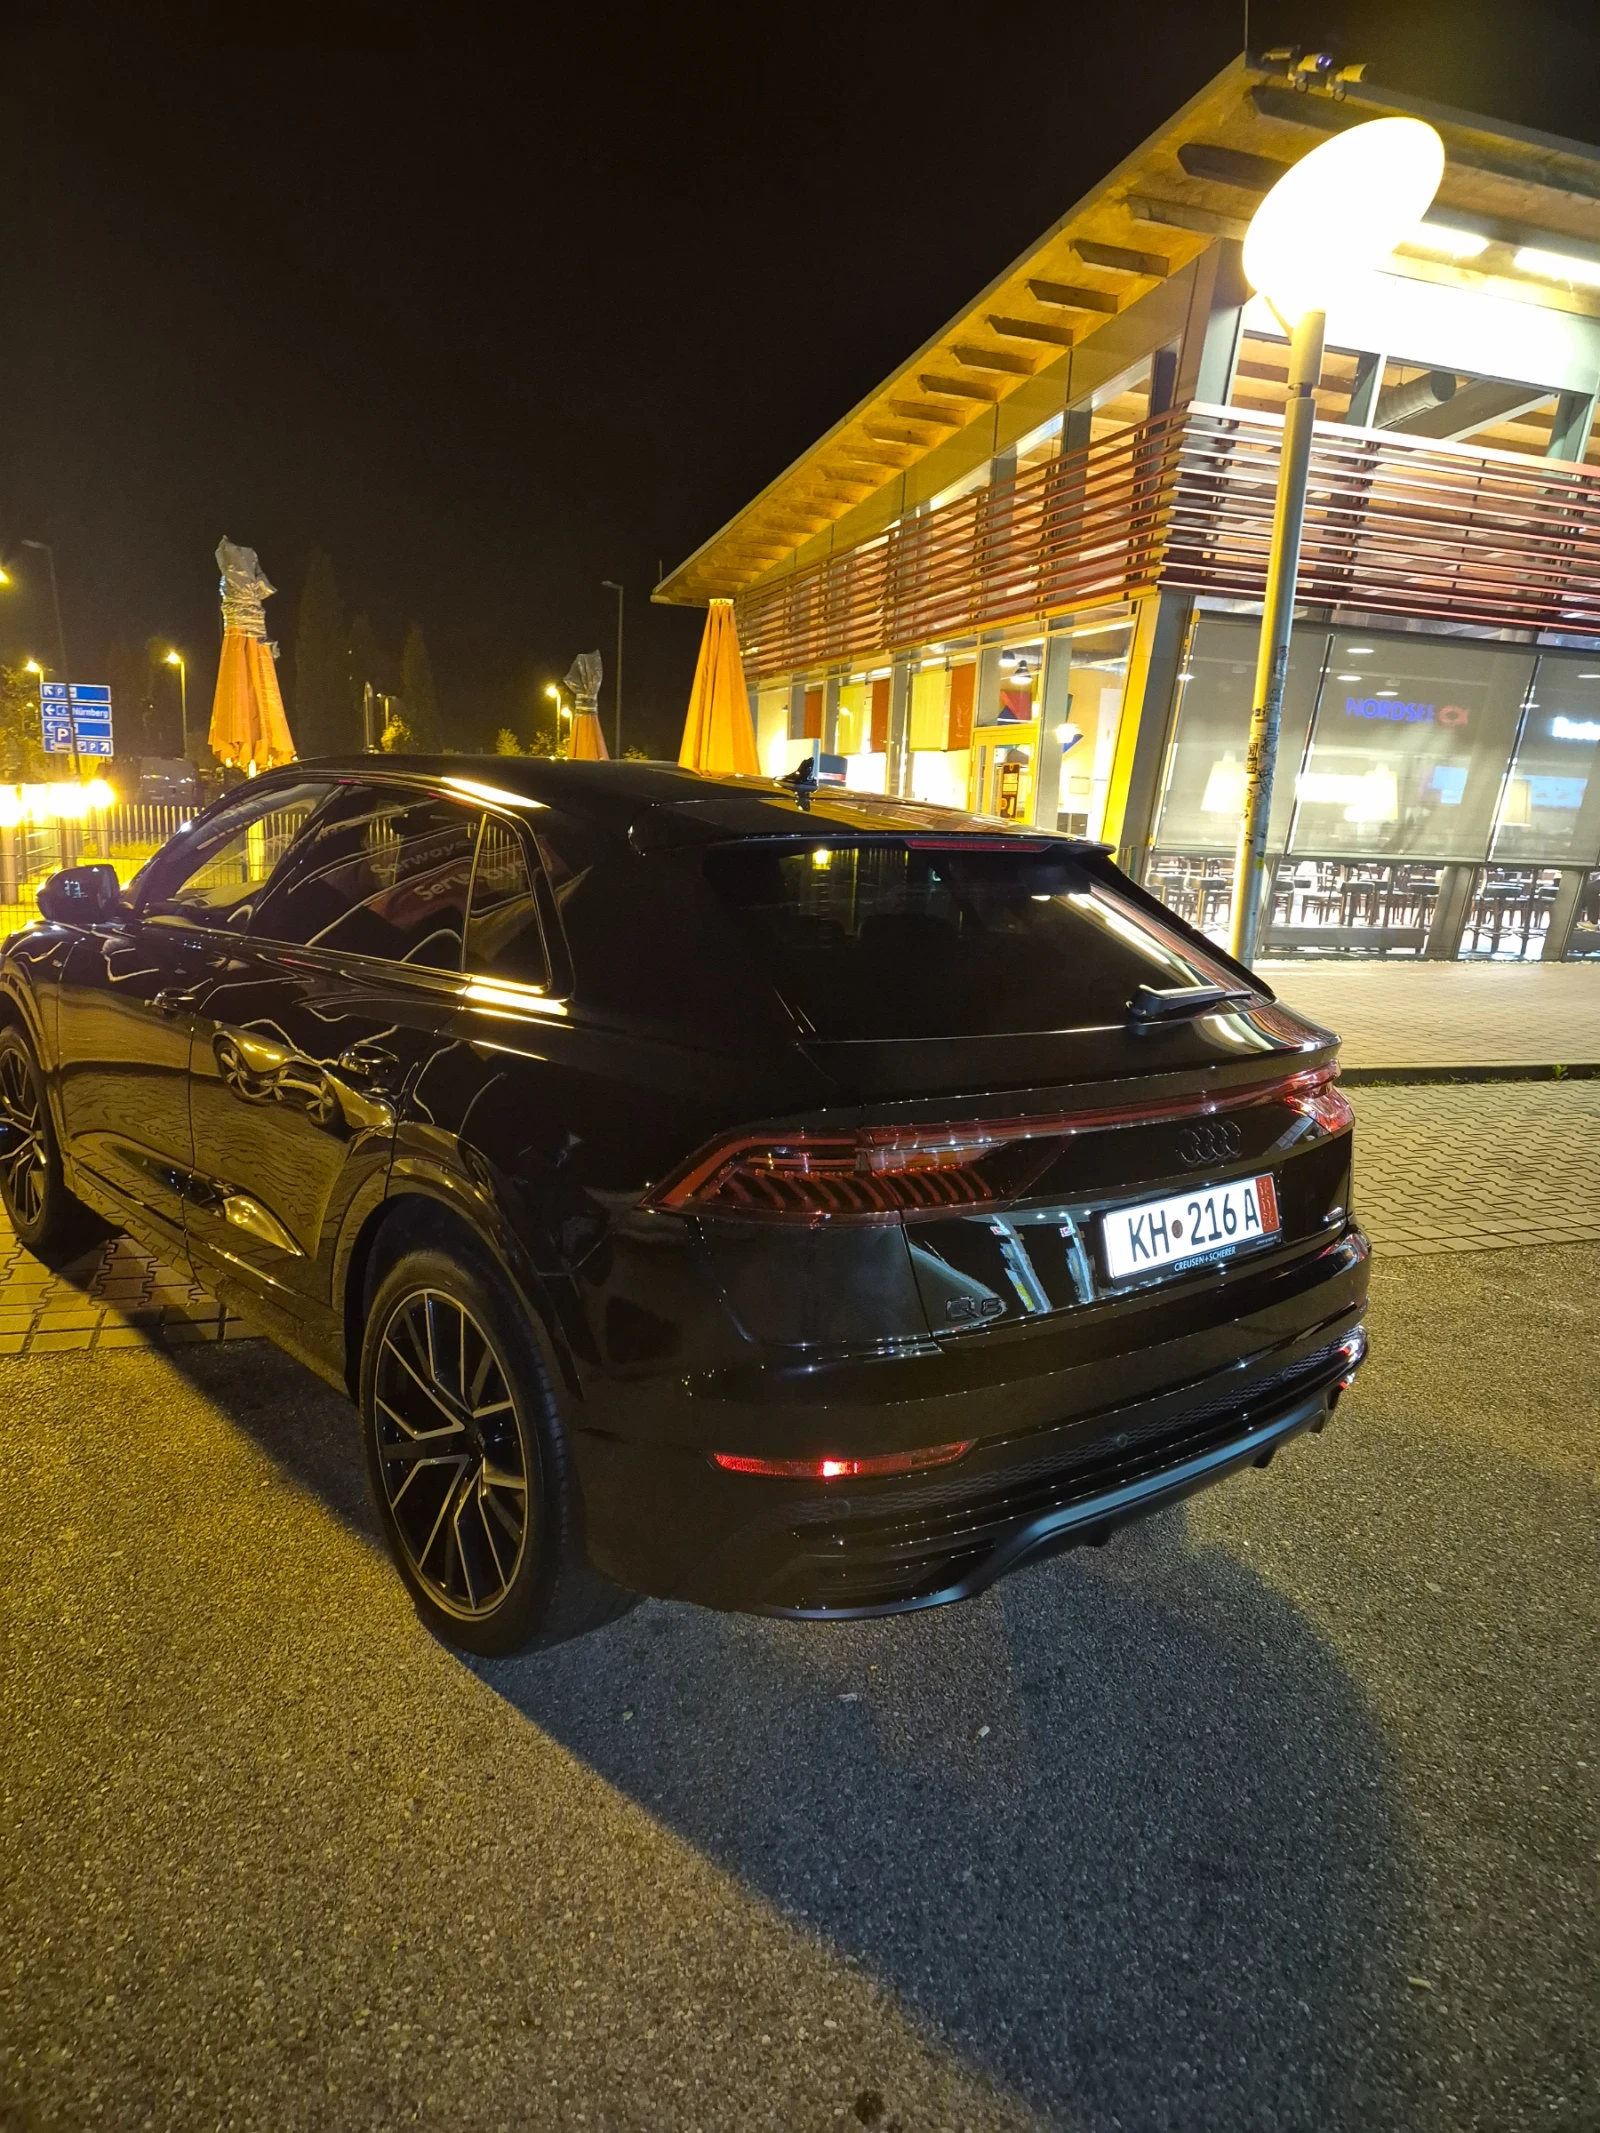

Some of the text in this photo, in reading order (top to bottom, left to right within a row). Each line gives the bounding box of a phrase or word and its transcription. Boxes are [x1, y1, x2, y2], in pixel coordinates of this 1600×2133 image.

[72, 707, 109, 719] Nürnberg
[1345, 697, 1435, 722] NORDSEE
[57, 728, 69, 741] P
[1128, 1210, 1170, 1262] KH
[1174, 1246, 1236, 1272] CREUSEN+SCHERER
[946, 1296, 1006, 1320] Q8
